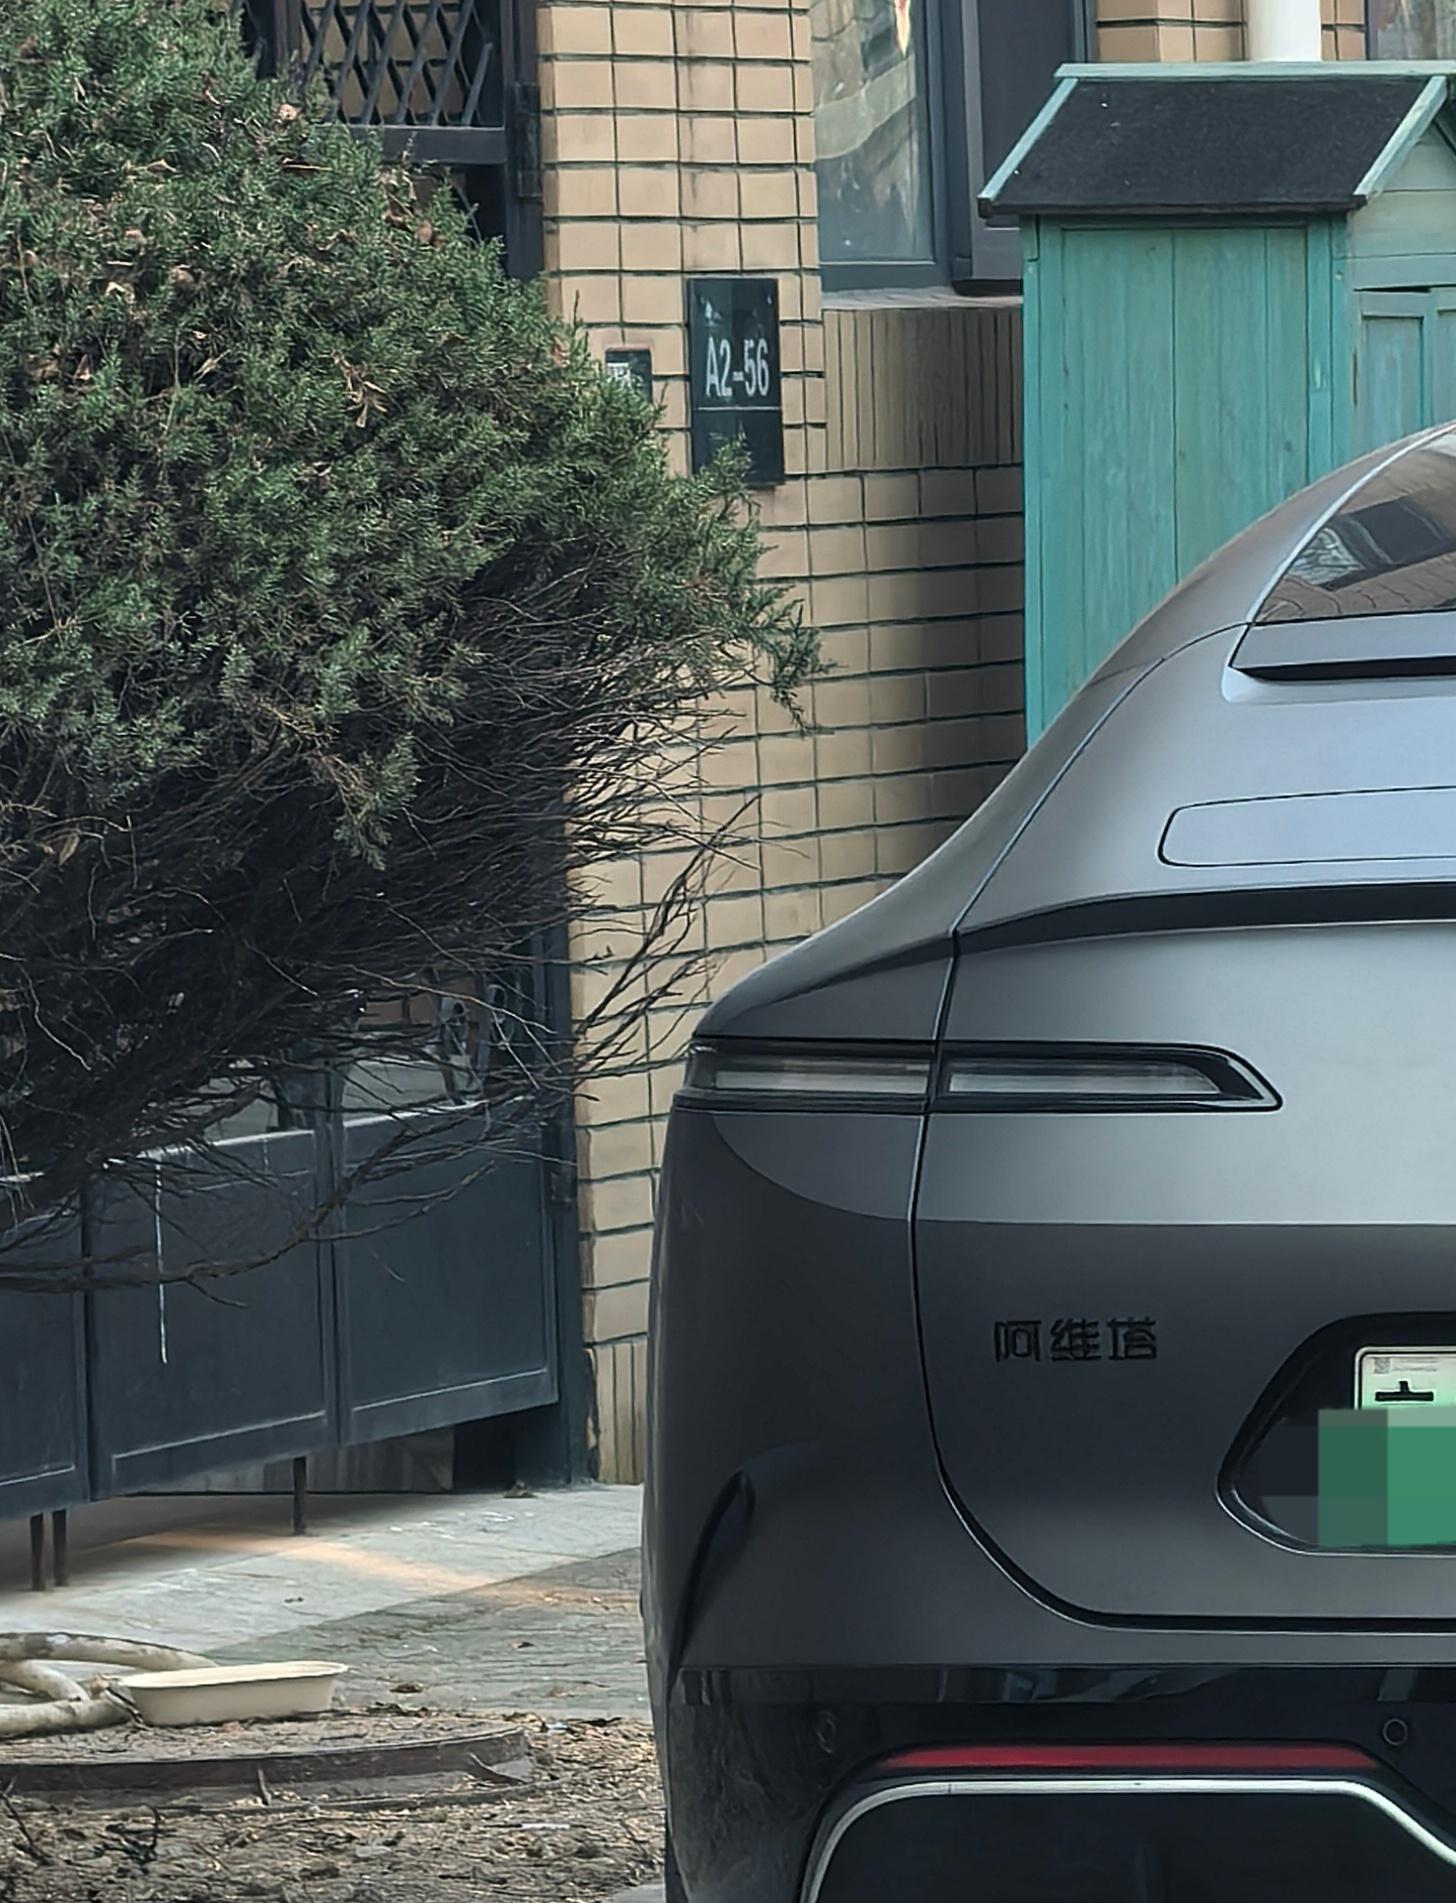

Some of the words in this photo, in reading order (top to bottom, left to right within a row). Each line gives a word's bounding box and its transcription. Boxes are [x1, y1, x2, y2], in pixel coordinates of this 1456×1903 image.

[705, 336, 770, 397] A2-56
[993, 1316, 1157, 1362] 阿维塔
